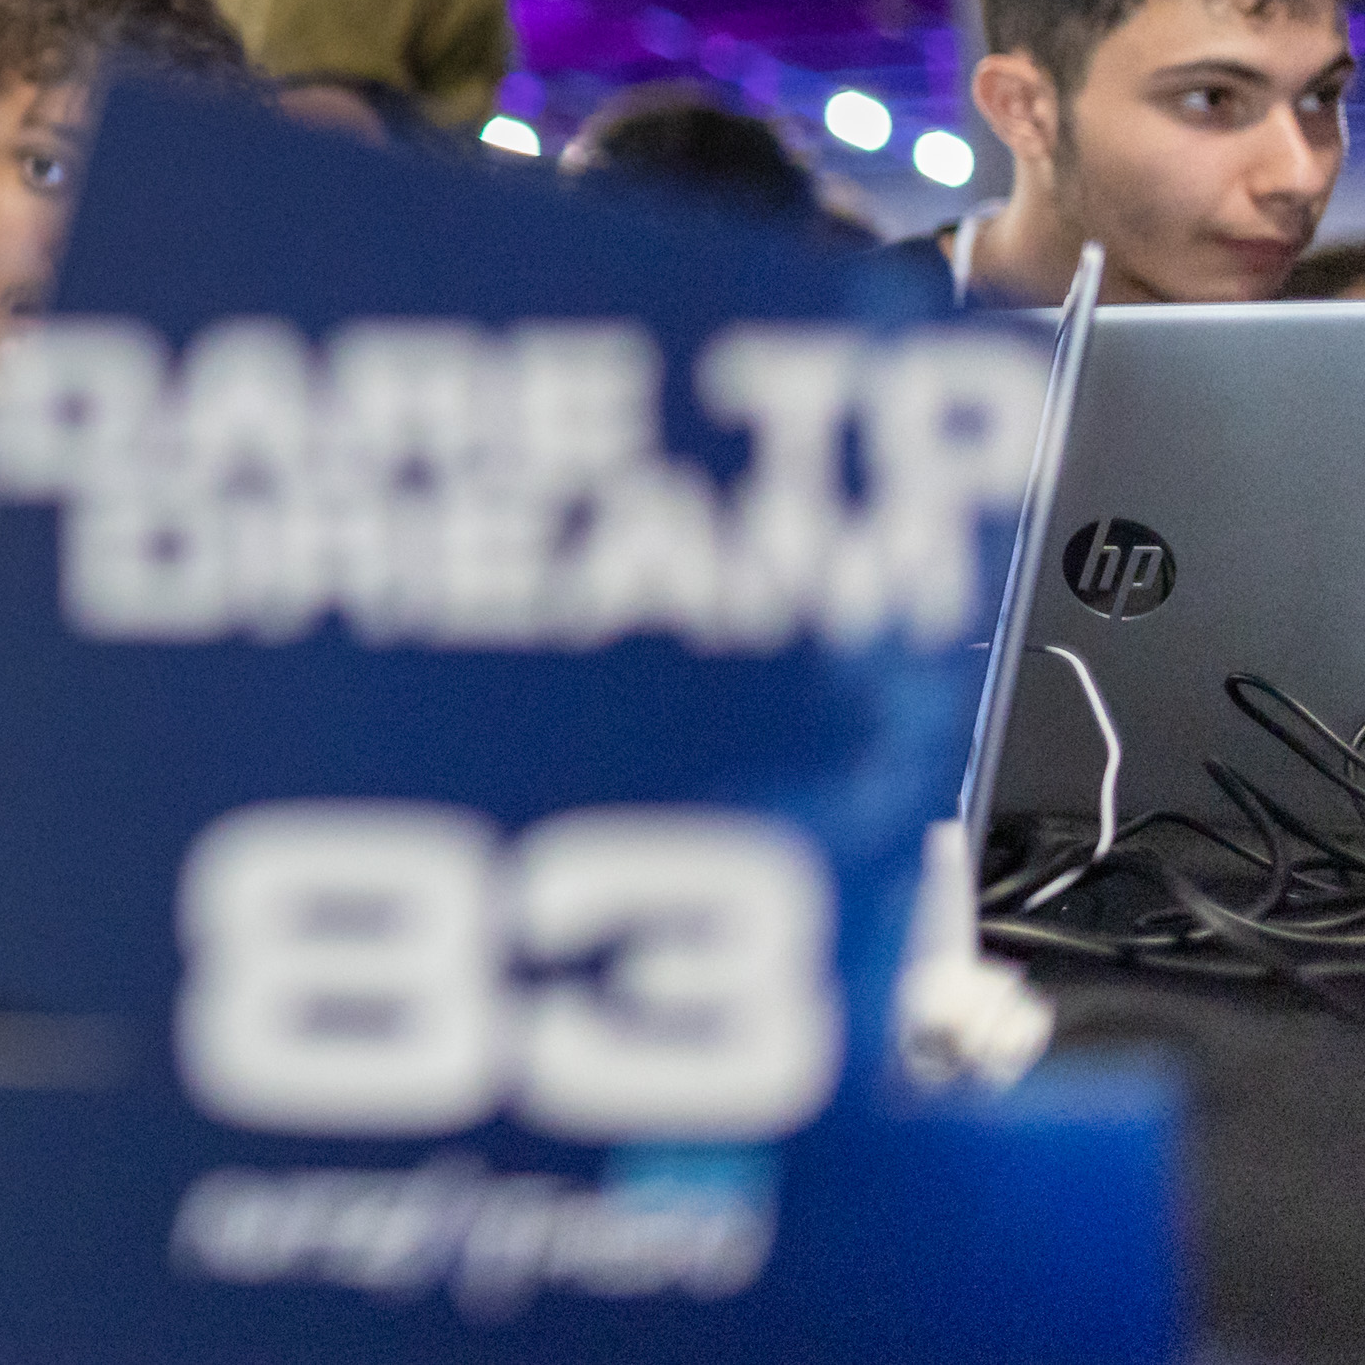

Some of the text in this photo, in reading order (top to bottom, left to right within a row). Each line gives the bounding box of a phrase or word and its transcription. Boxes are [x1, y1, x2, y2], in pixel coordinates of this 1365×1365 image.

[59, 466, 983, 652] DREAM
[1077, 517, 1165, 620] hp
[175, 796, 849, 1144] 83
